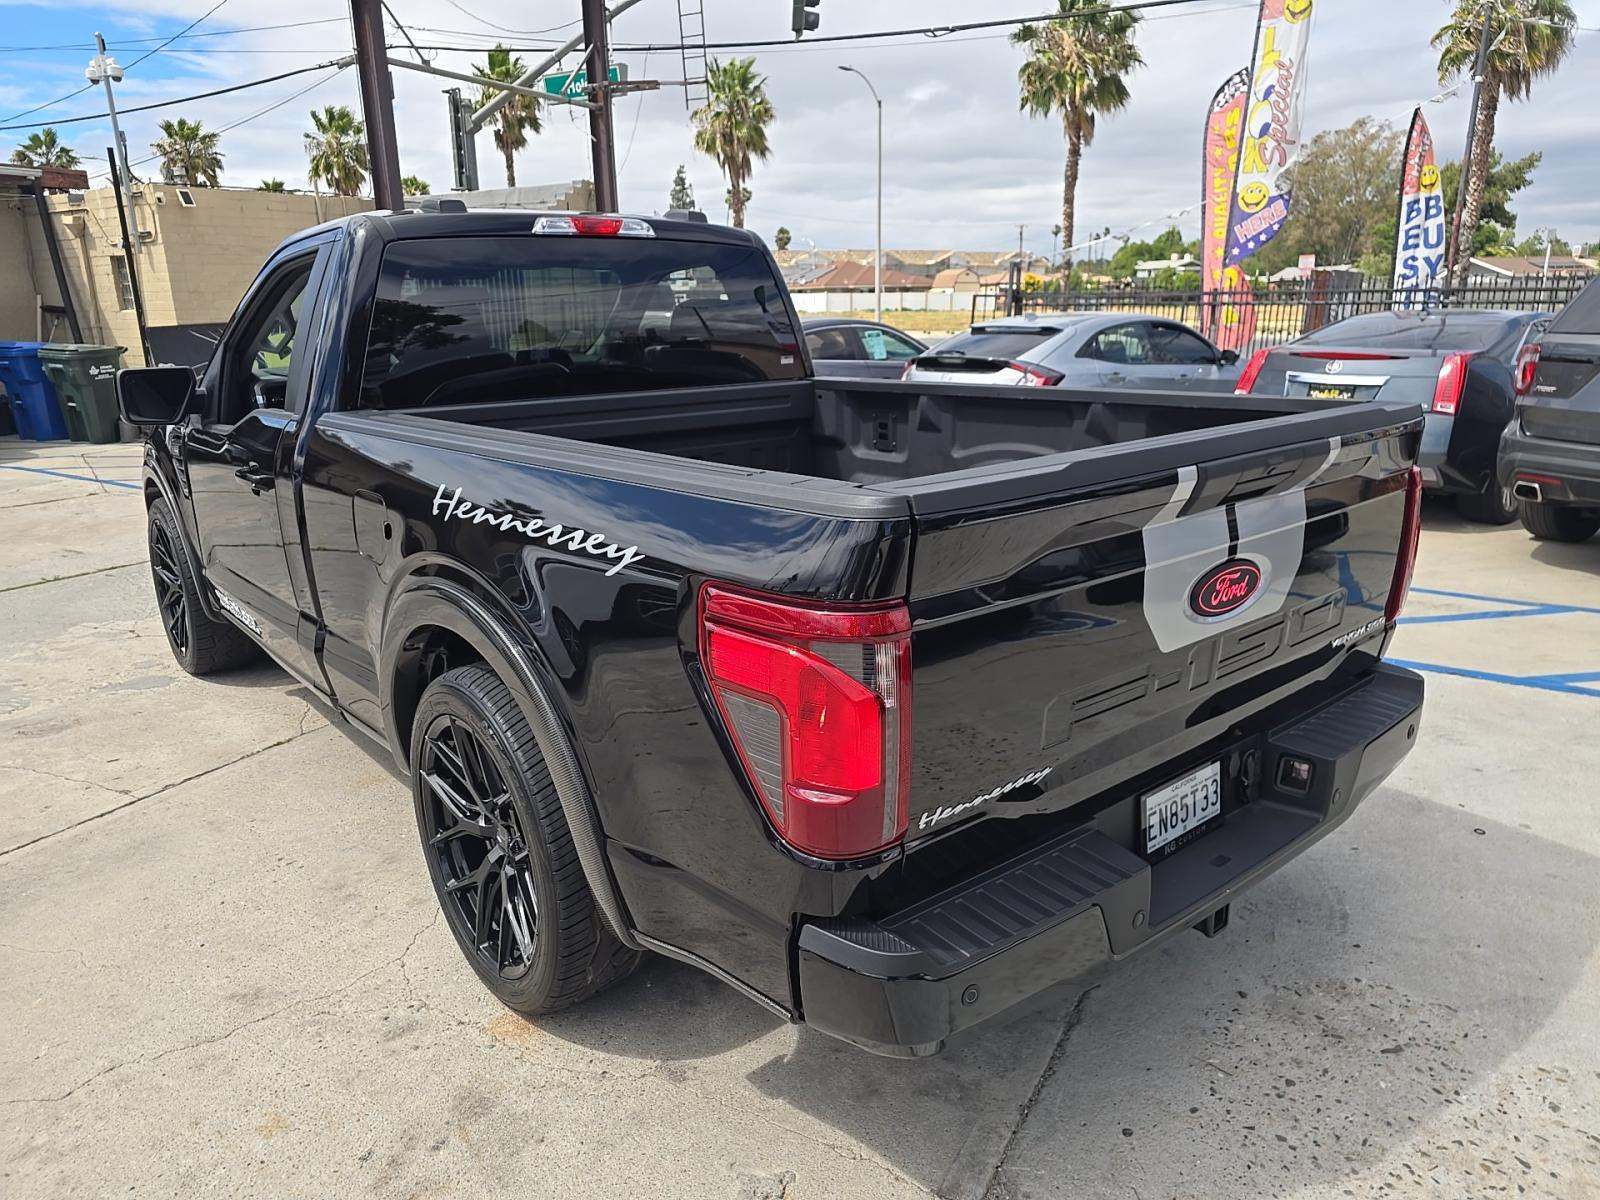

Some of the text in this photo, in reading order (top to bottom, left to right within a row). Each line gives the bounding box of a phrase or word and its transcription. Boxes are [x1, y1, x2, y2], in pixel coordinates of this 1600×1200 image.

[1259, 57, 1296, 168] Special
[1234, 198, 1287, 244] HERE
[432, 483, 646, 577] Hennessey
[1211, 572, 1248, 606] Ford
[1041, 587, 1347, 750] F-150
[918, 766, 1053, 830] Hennessey
[1147, 778, 1219, 843] EN85T33
